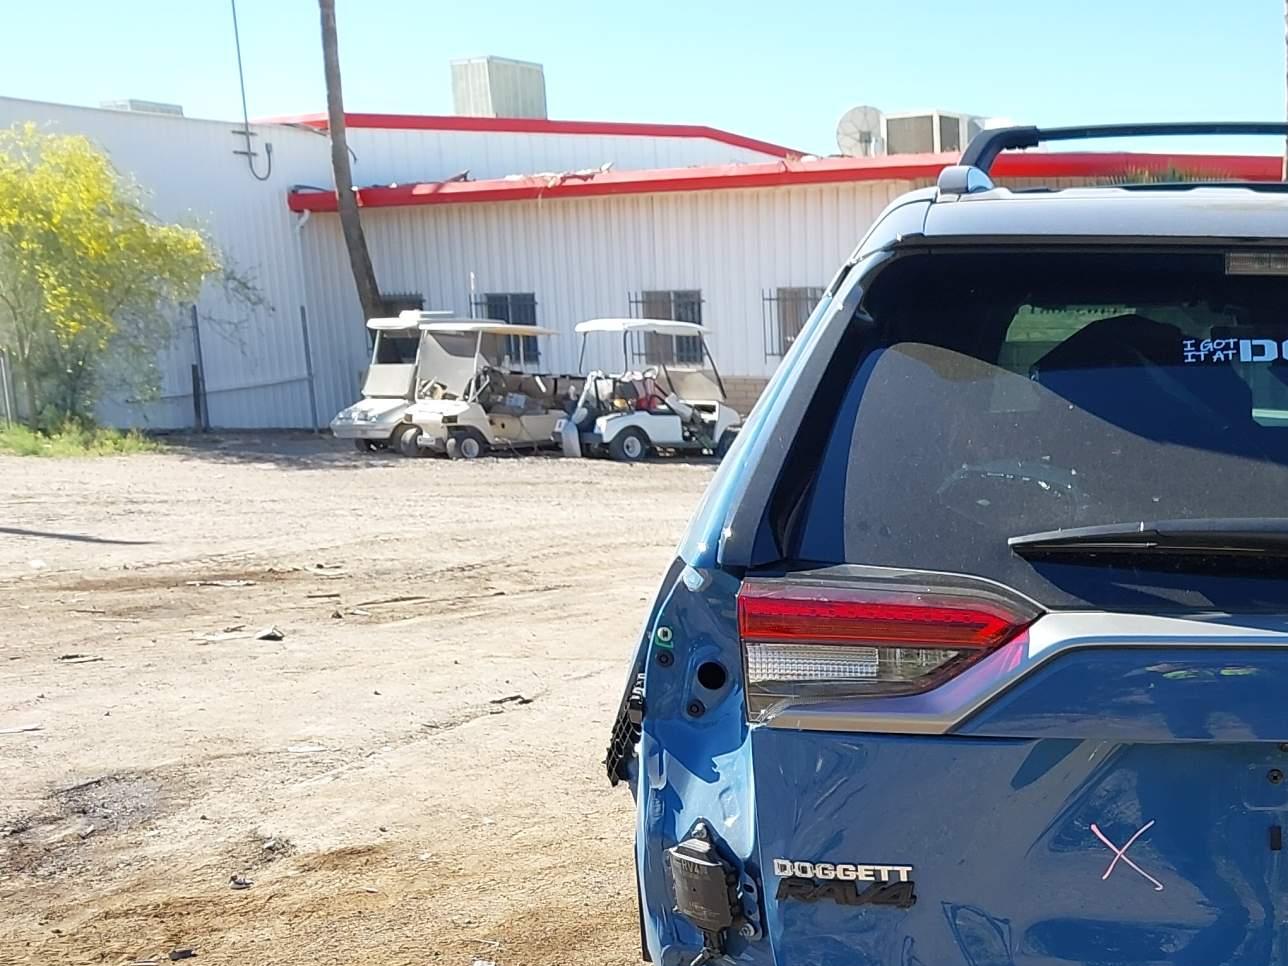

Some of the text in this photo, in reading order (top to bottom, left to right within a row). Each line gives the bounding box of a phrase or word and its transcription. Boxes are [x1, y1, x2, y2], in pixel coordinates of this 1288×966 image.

[1183, 338, 1238, 351] I GOT
[1184, 350, 1237, 363] IT AT
[773, 858, 913, 881] DOGGETT
[776, 877, 917, 908] RAV4
